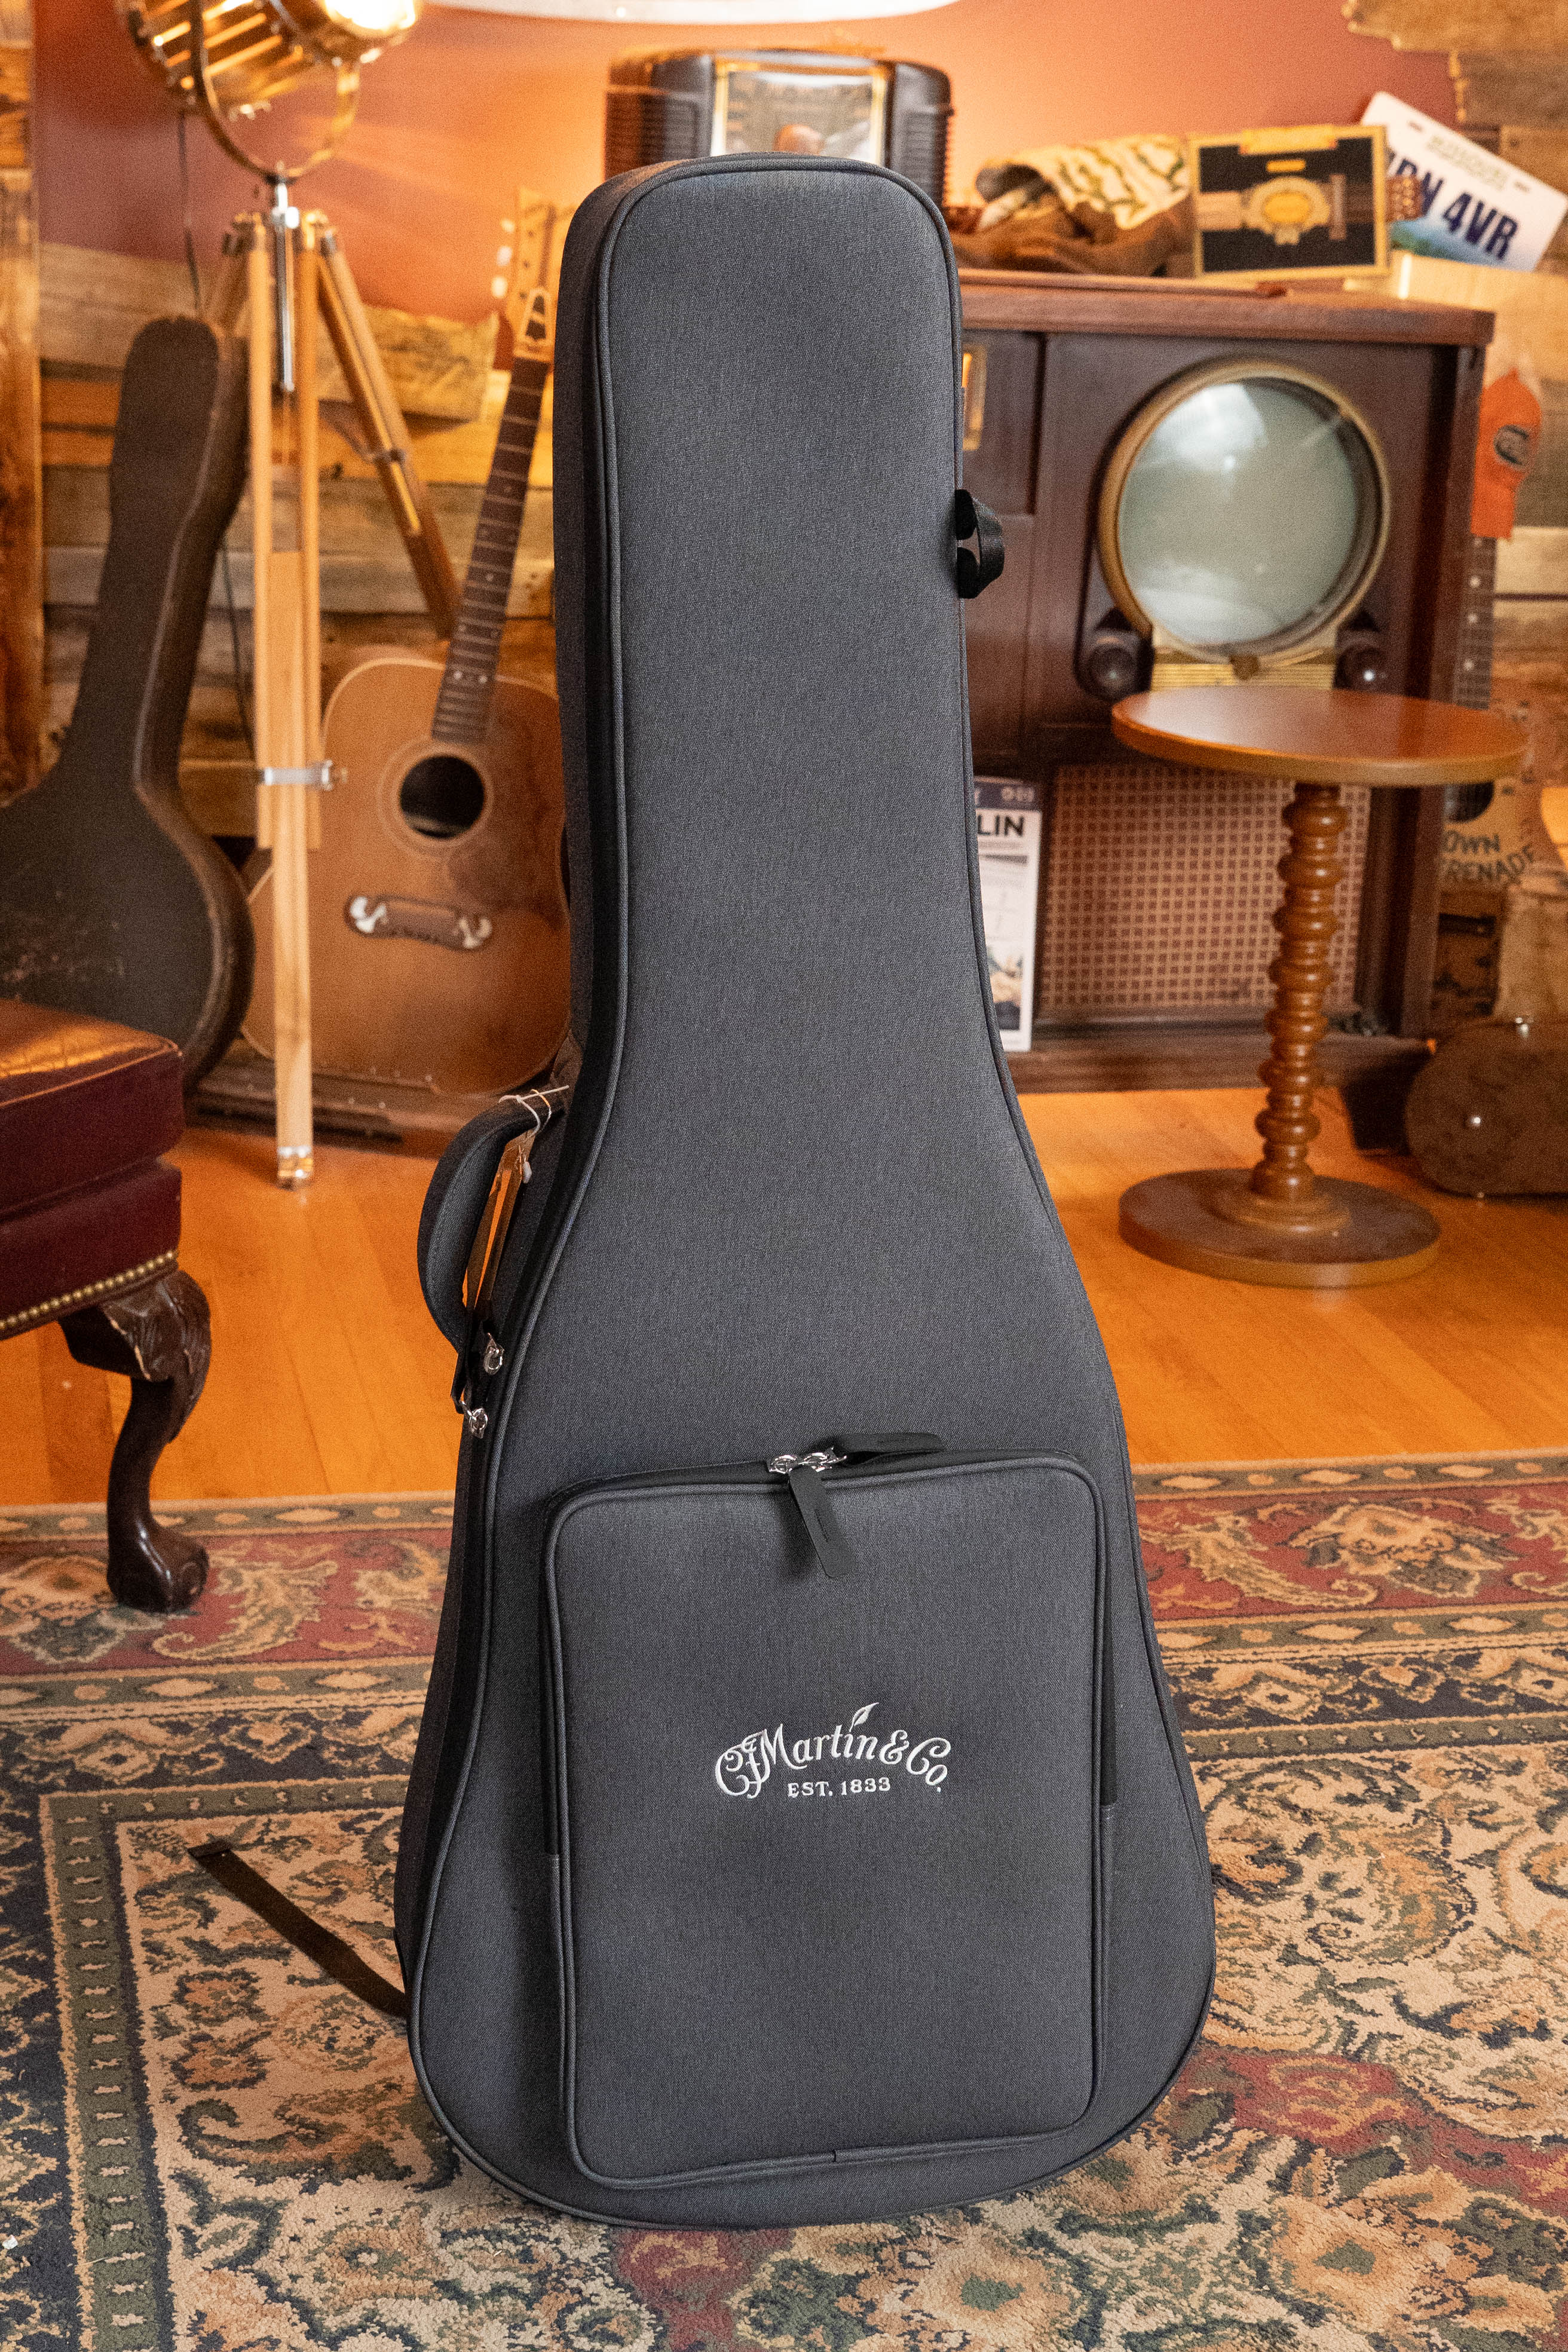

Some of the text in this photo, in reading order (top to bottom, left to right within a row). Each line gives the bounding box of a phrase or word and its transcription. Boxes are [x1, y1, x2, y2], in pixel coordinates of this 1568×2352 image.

[1443, 192, 1518, 261] 4VR
[788, 1777, 891, 1798] EST. 1833
